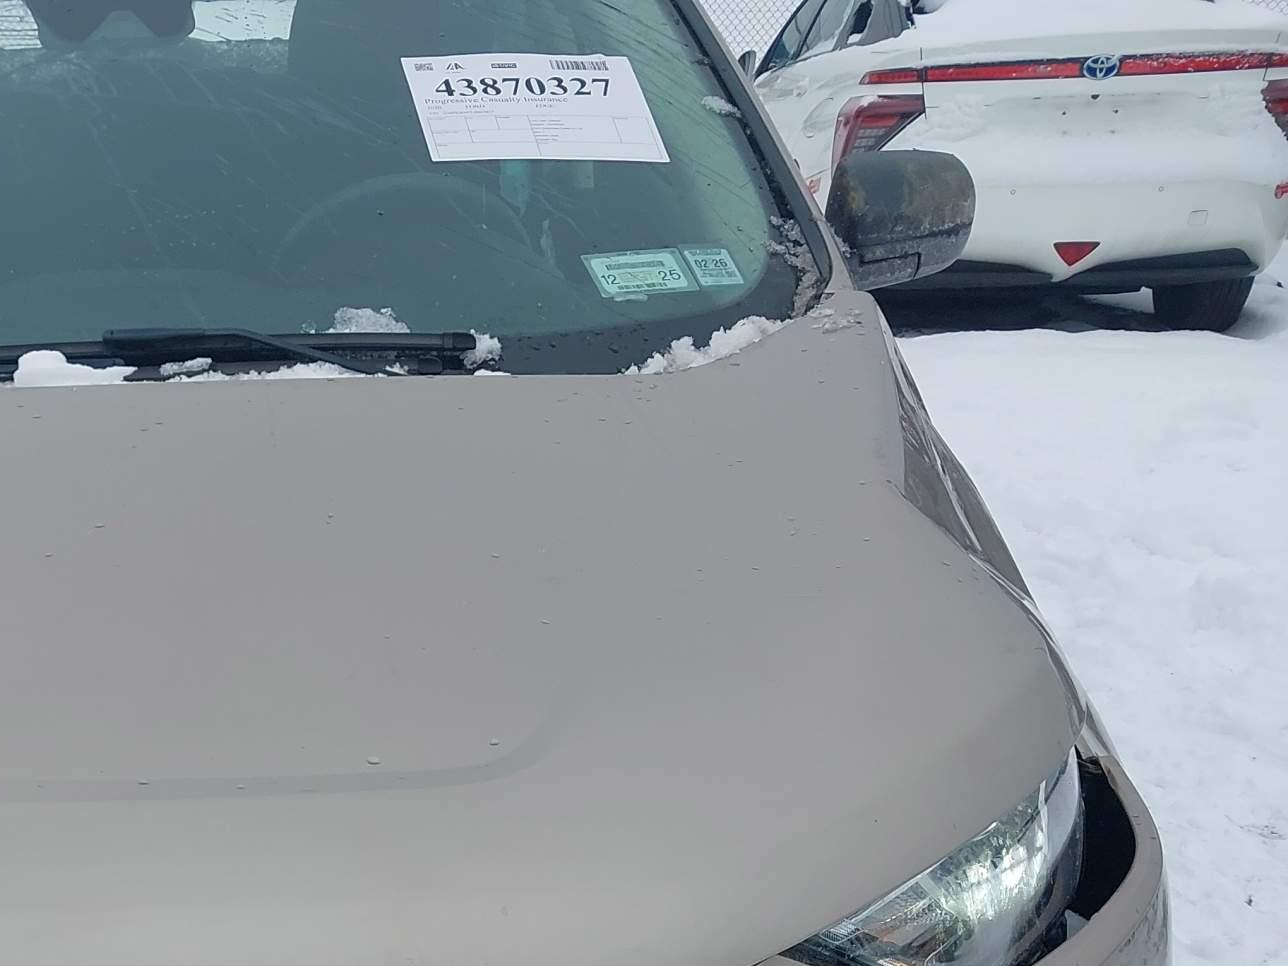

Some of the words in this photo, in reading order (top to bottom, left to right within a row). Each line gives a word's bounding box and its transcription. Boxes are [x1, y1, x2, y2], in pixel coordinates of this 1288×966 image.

[435, 77, 610, 97] 43870327
[424, 97, 479, 105] Progressive
[480, 96, 520, 104] Casualty
[600, 274, 620, 286] 12
[657, 269, 681, 281] 25
